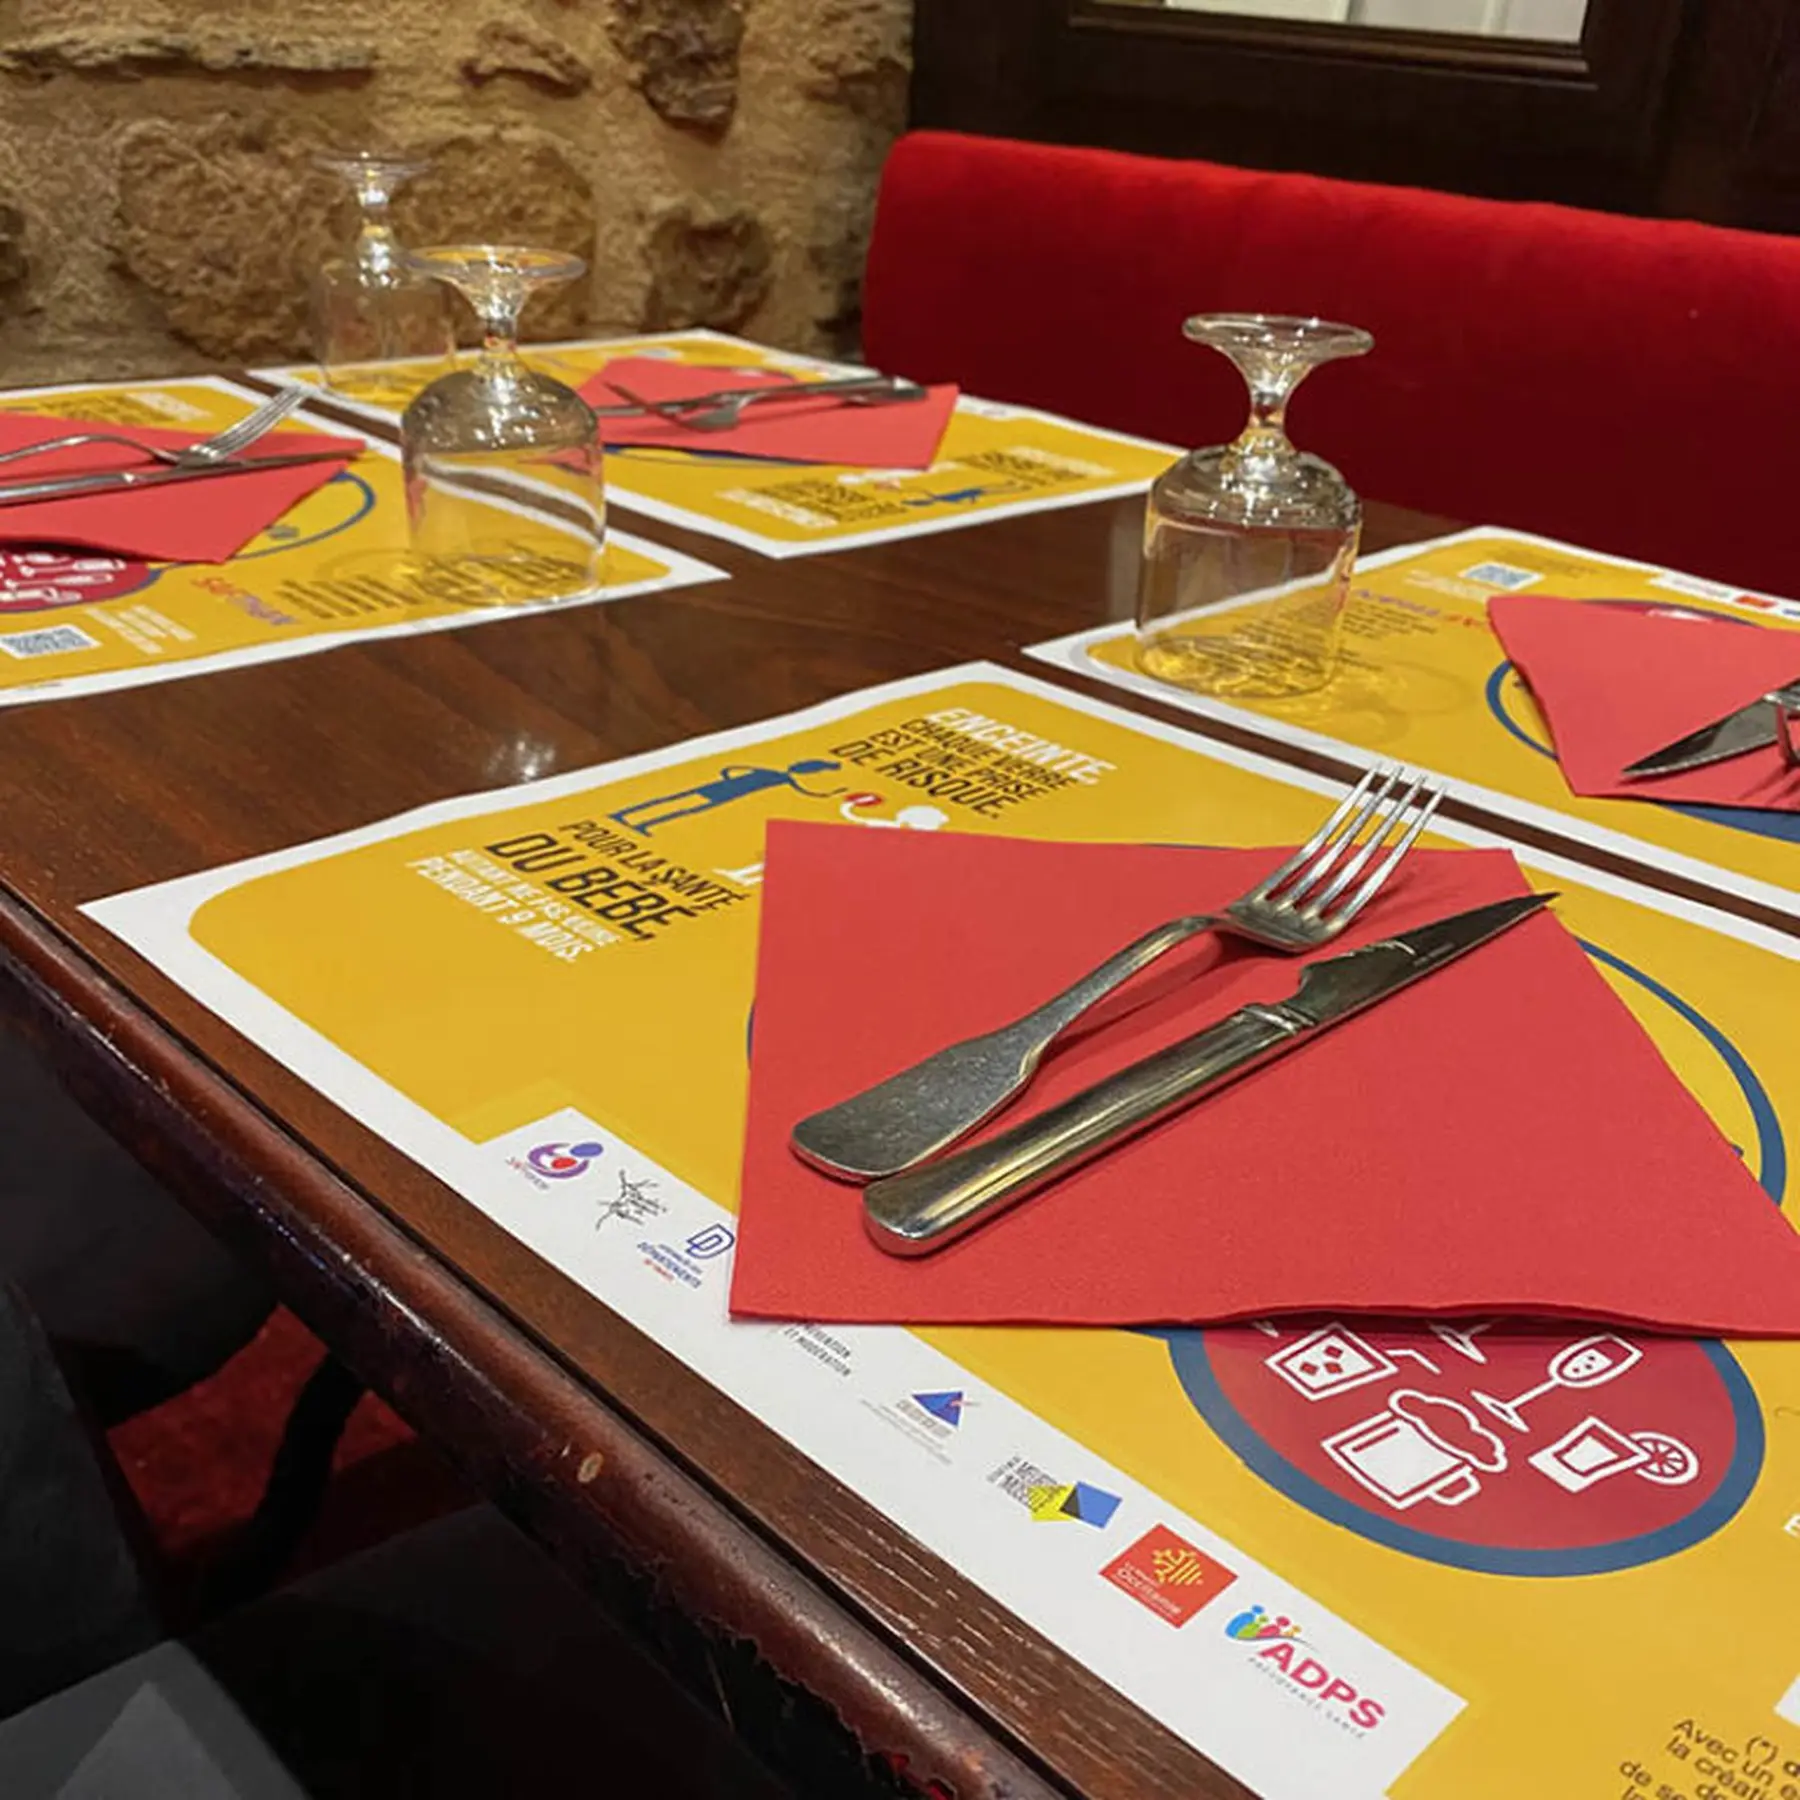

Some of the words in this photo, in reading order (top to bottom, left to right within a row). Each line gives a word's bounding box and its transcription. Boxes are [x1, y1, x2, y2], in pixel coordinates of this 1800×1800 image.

[869, 728, 925, 752] EST
[916, 748, 978, 773] UNE
[962, 766, 1050, 801] PRISE
[901, 718, 996, 761] CHAQUE
[925, 707, 1117, 785] ENCEINTE
[829, 740, 898, 767] DE
[874, 758, 1018, 820] RISQUE.
[484, 832, 587, 873] DU
[558, 820, 638, 859] POUR
[617, 850, 668, 874] LA
[1257, 1641, 1386, 1730] ADPS
[1619, 1760, 1653, 1788] de
[1665, 1735, 1692, 1761] la
[1673, 1718, 1739, 1765] Avec
[1741, 1759, 1775, 1787] un
